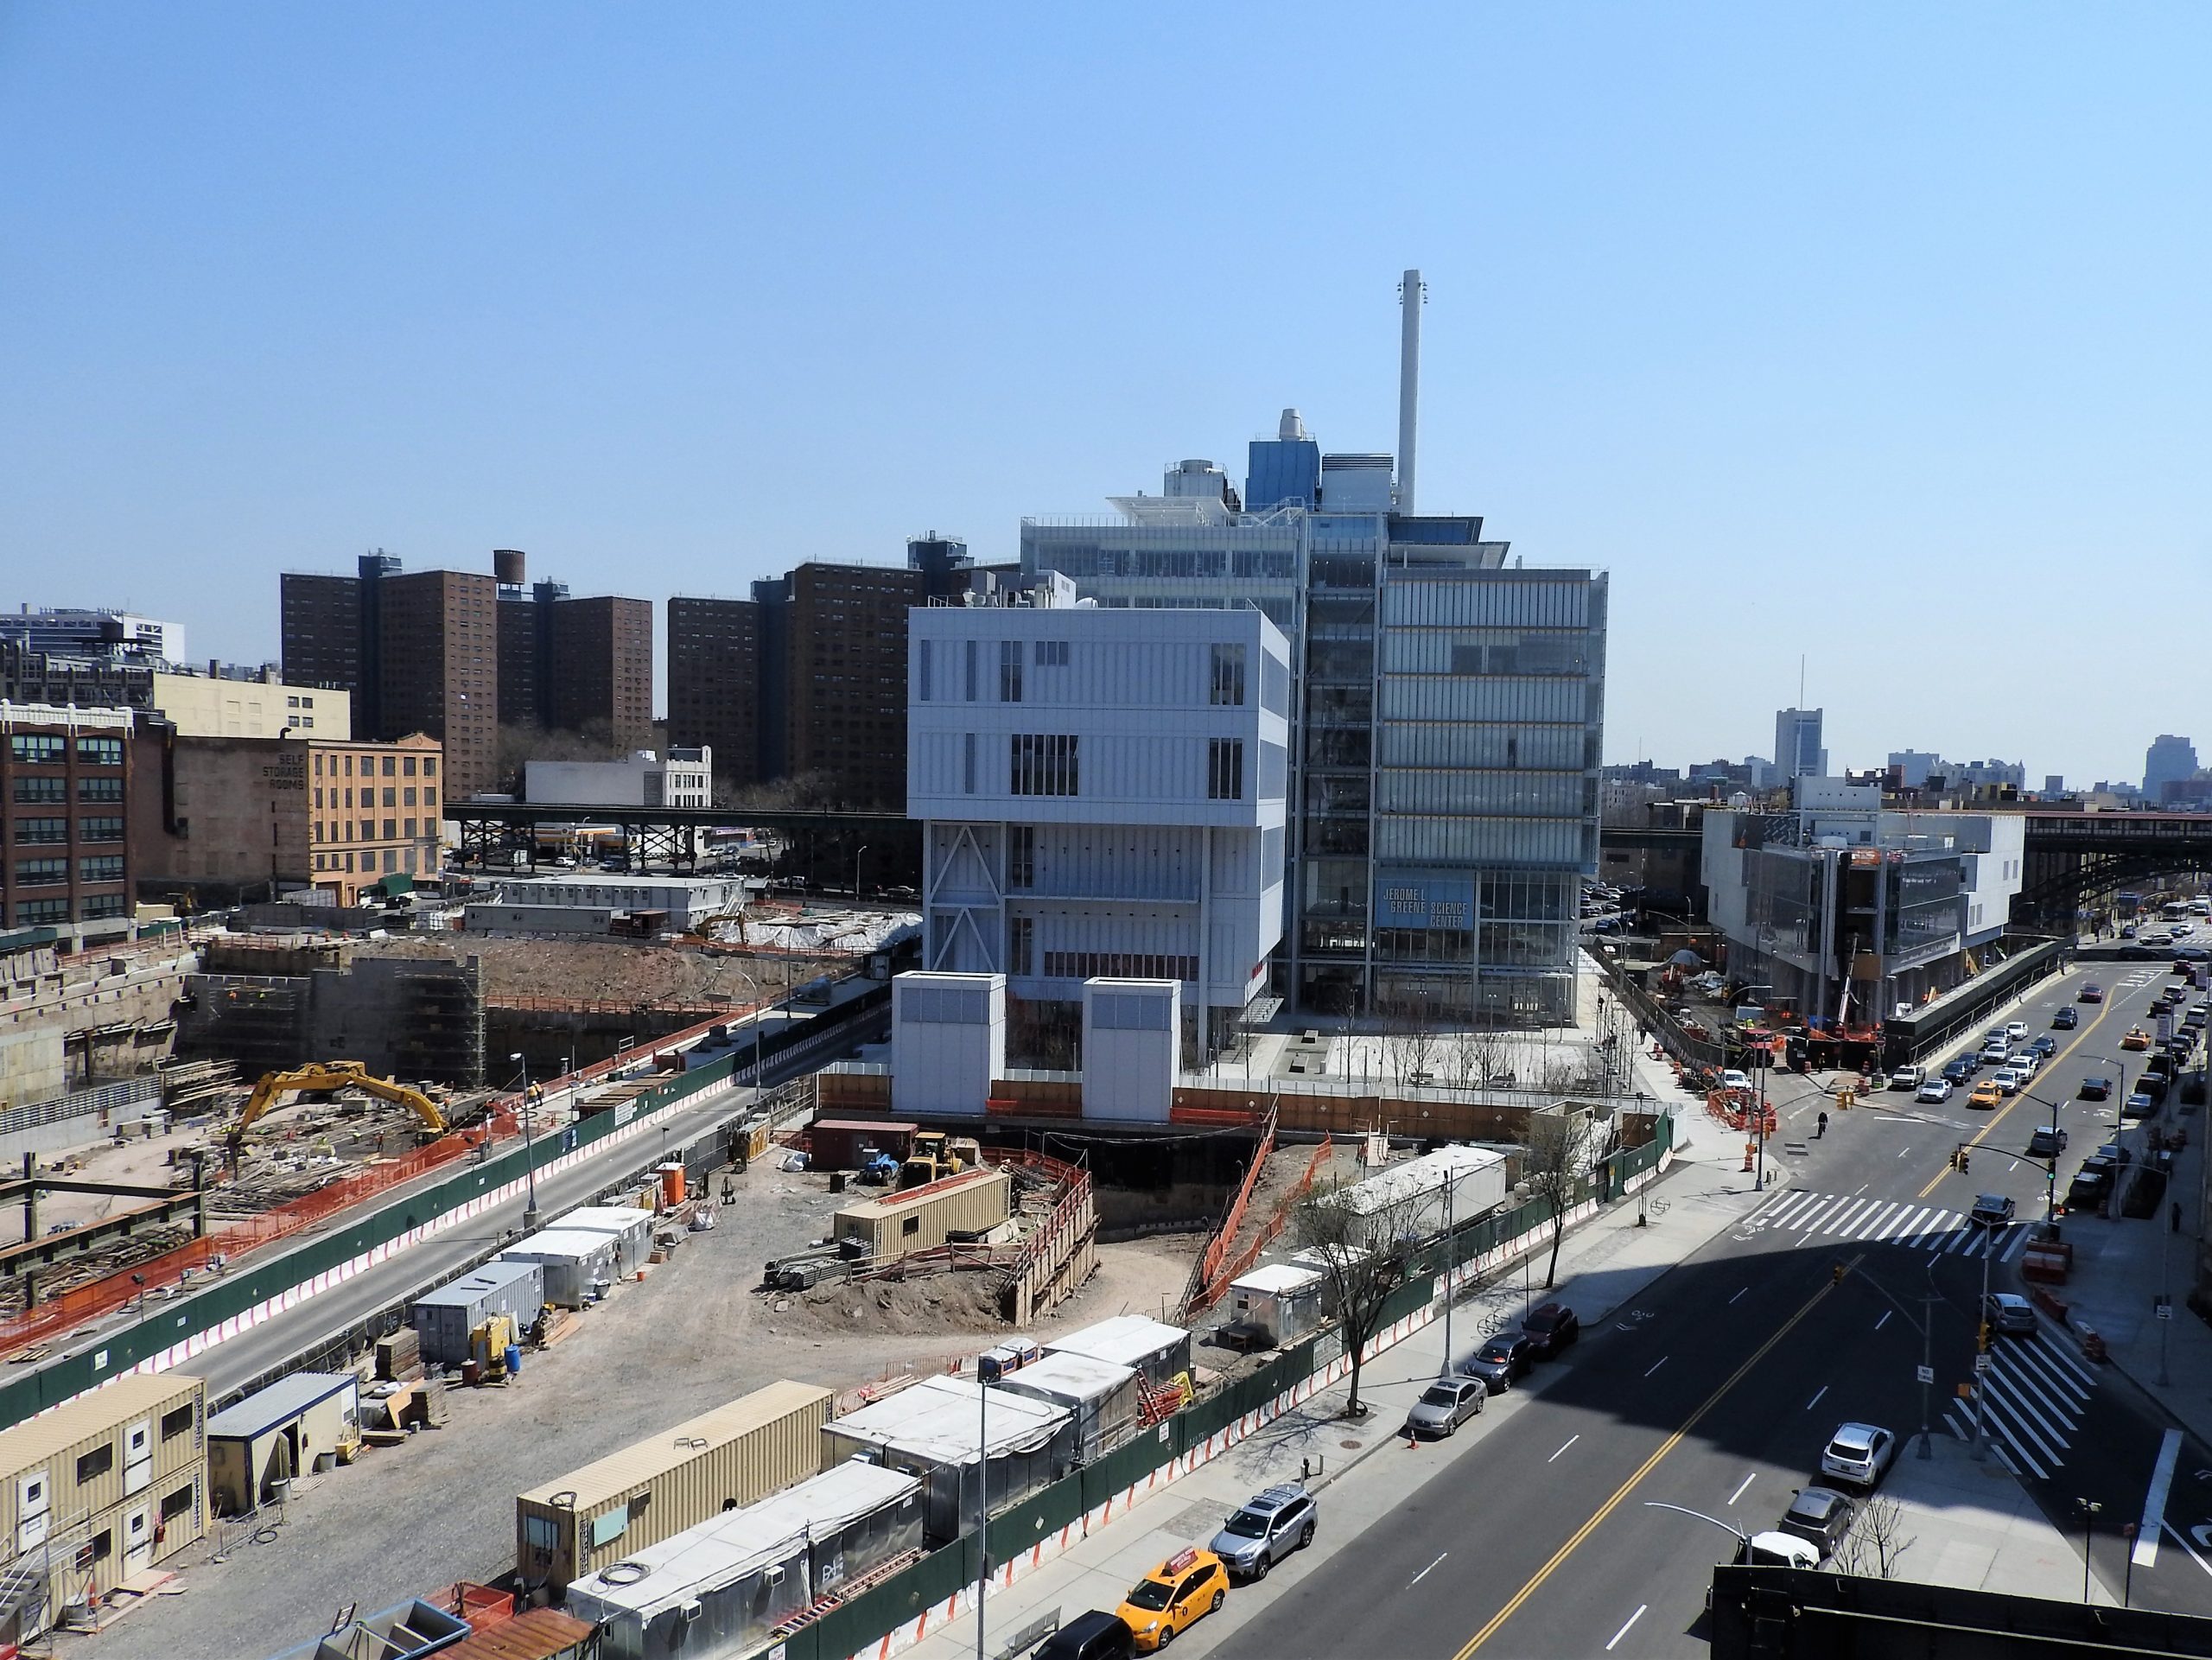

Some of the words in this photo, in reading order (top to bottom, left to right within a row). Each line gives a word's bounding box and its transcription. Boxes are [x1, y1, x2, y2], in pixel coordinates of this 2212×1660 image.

[279, 754, 304, 765] SELF
[263, 766, 304, 778] STORAGE
[269, 779, 304, 790] ROOMS
[1383, 887, 1418, 900] JEROME
[1390, 900, 1426, 913] GREENE
[1431, 902, 1467, 915] SCIENCE
[1431, 915, 1464, 927] CENTER
